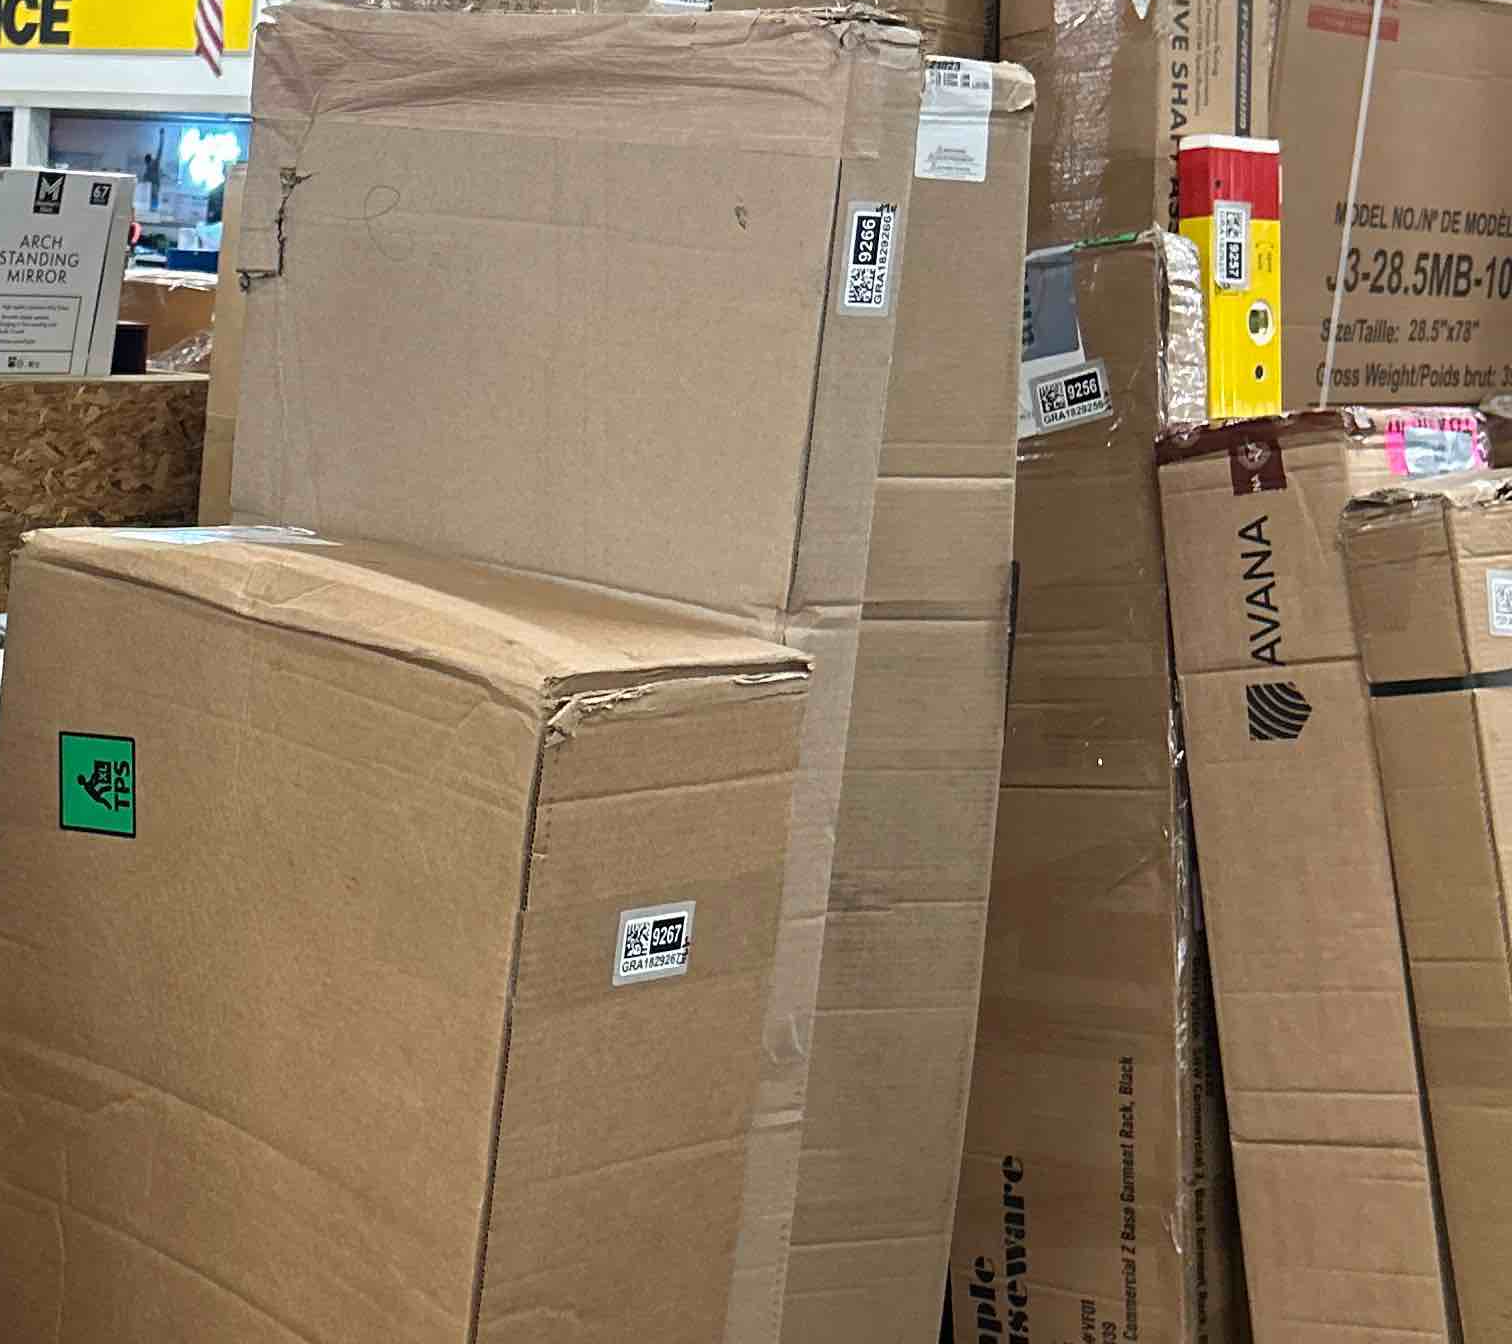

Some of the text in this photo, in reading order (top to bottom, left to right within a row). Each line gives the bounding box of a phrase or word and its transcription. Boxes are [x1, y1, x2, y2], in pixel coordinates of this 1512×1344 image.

[93, 185, 110, 199] 67
[1440, 210, 1461, 234] DE
[20, 235, 63, 249] ARCH
[858, 219, 876, 263] 9266
[0, 251, 80, 268] STANDING
[1228, 243, 1240, 277] 9257
[7, 269, 67, 284] MIRROR
[1320, 318, 1400, 343] Sze/Taille:
[1067, 378, 1098, 399] 9256
[1365, 363, 1460, 393] Weight/Poids
[1238, 515, 1287, 667] AVANA
[114, 760, 130, 812] TPS
[652, 924, 682, 946] 9267
[1117, 1056, 1134, 1096] Black
[1118, 1101, 1137, 1139] Rack,
[1119, 1143, 1136, 1202] Garment
[1120, 1206, 1137, 1241] Base
[1120, 1260, 1139, 1341] Commercial
